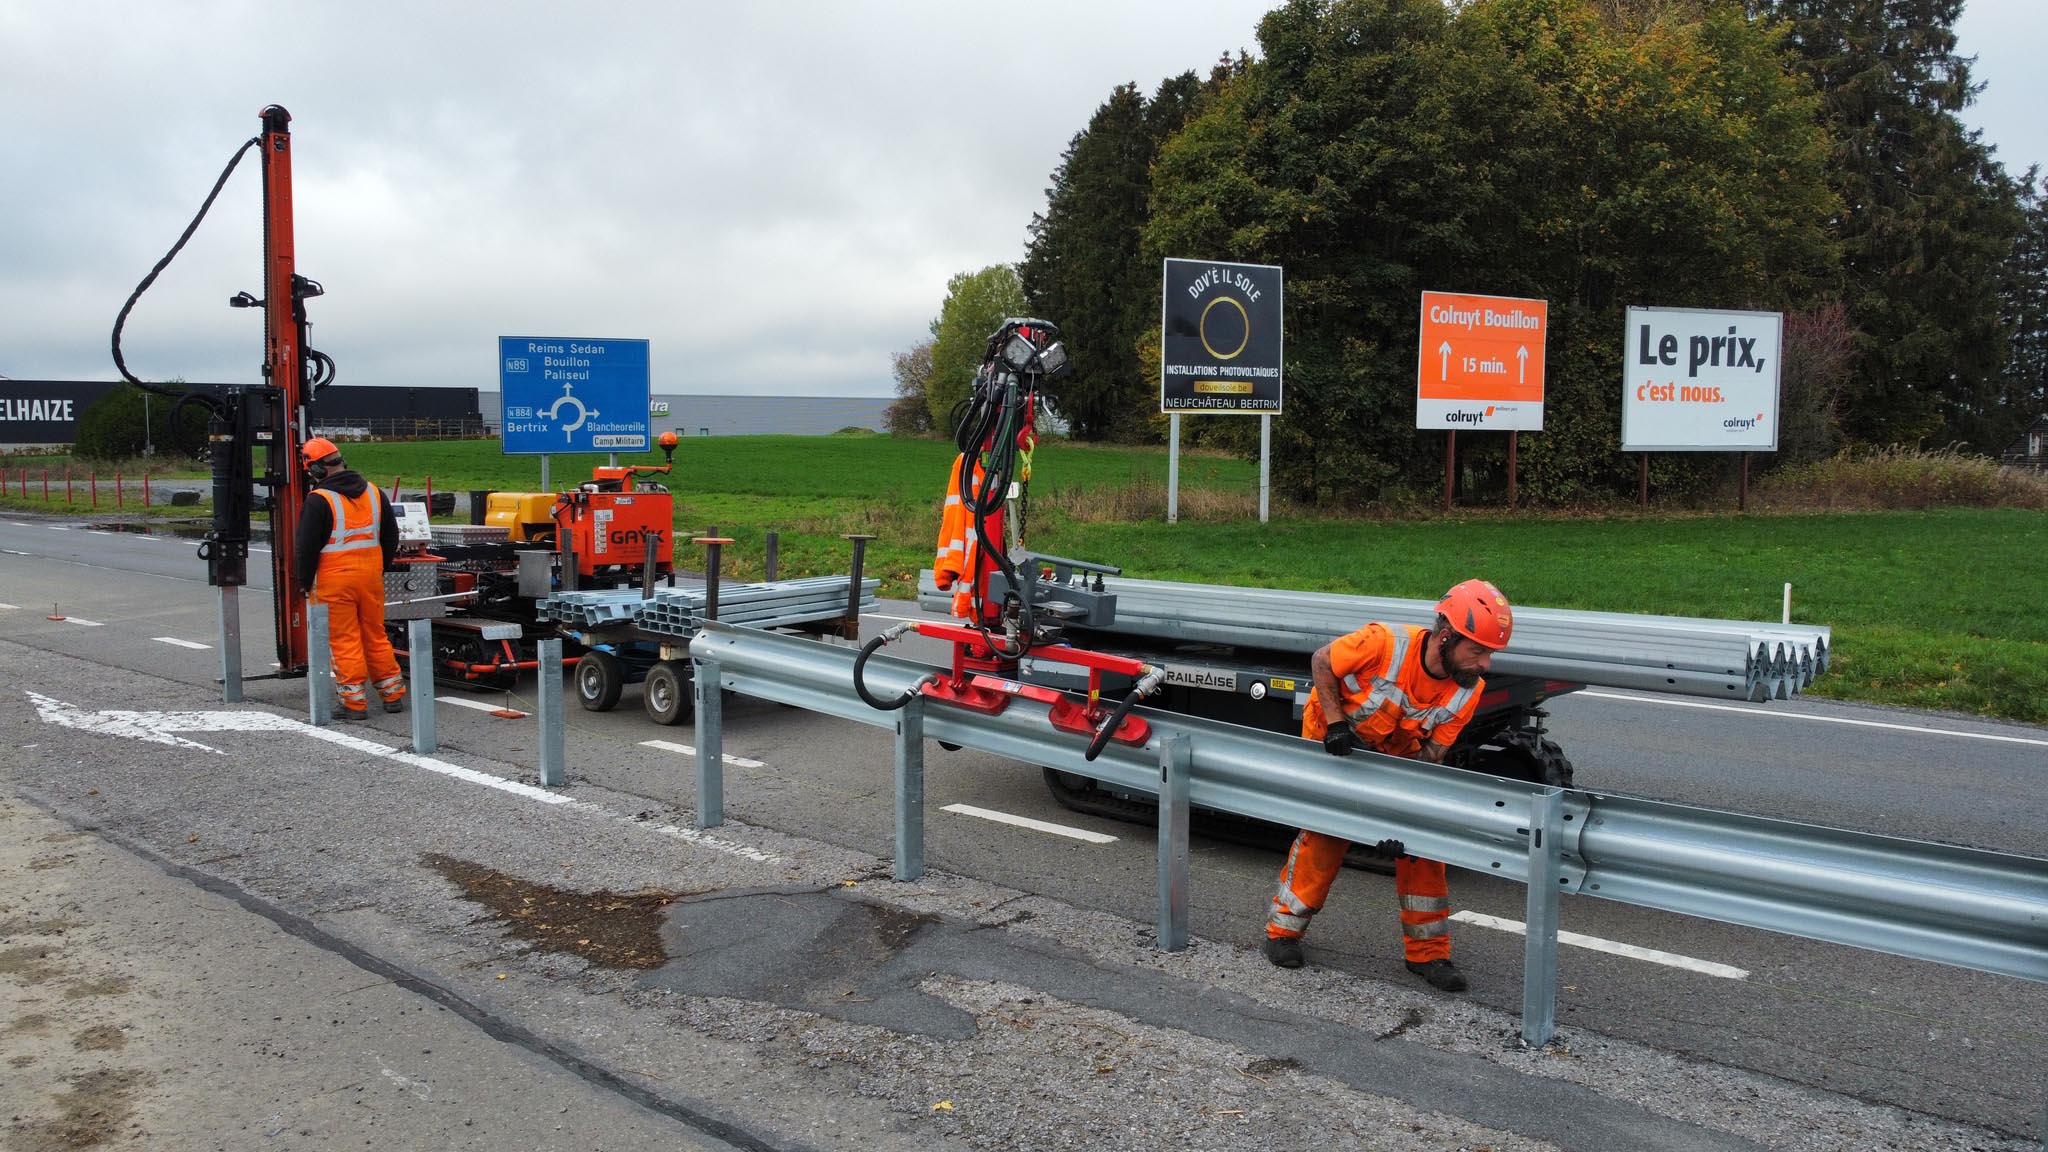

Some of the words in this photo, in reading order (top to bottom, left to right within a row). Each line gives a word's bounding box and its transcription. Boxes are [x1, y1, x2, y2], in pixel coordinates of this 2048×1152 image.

[1222, 269, 1232, 284] IL
[1234, 273, 1261, 303] SOLE
[1430, 305, 1481, 330] Colruyt
[1484, 308, 1539, 329] Bouillon
[528, 343, 564, 353] Reims
[570, 344, 605, 354] Sedan
[1639, 324, 1678, 366] Le
[1688, 325, 1766, 378] prix,
[508, 360, 526, 370] N89
[544, 356, 590, 367] Bouillon
[1462, 357, 1477, 373] 15
[1480, 357, 1507, 374] min.
[544, 369, 589, 380] Paliseul
[1166, 365, 1217, 376] INSTALLATIONS
[1219, 366, 1279, 378] PHOTOVOLTAÏQUES
[1637, 380, 1675, 402] c'est
[1680, 386, 1725, 403] nous.
[1166, 396, 1236, 408] NEUFCHÂTEAU
[1240, 399, 1279, 409] BERTRIX
[1446, 410, 1484, 426] colruyt
[1723, 417, 1755, 430] colruyt
[508, 422, 548, 432] Bertrix
[594, 437, 614, 446] Camp
[615, 436, 644, 445] Militaire
[1272, 679, 1286, 689] DIESEL
